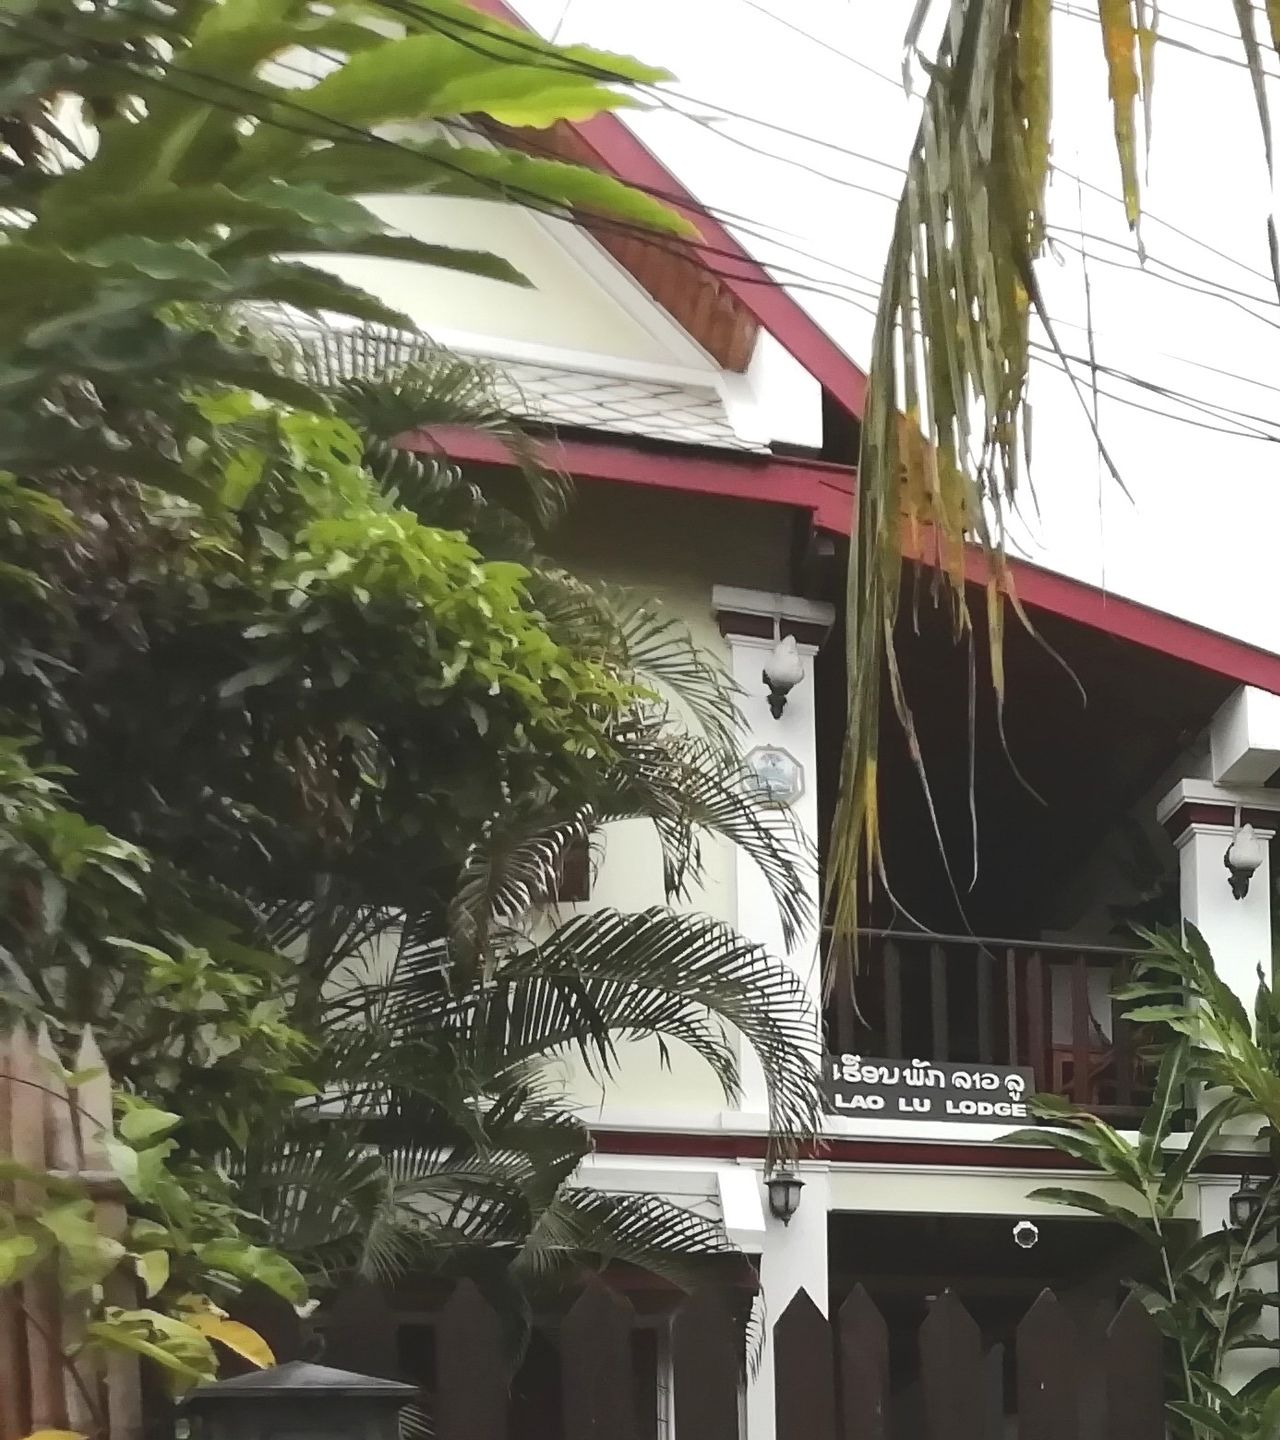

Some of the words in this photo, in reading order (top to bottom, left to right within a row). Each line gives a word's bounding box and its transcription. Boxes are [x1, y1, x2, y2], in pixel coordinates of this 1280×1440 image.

[834, 1093, 885, 1110] LAO
[898, 1097, 931, 1113] LU
[946, 1099, 1027, 1118] LODGE
